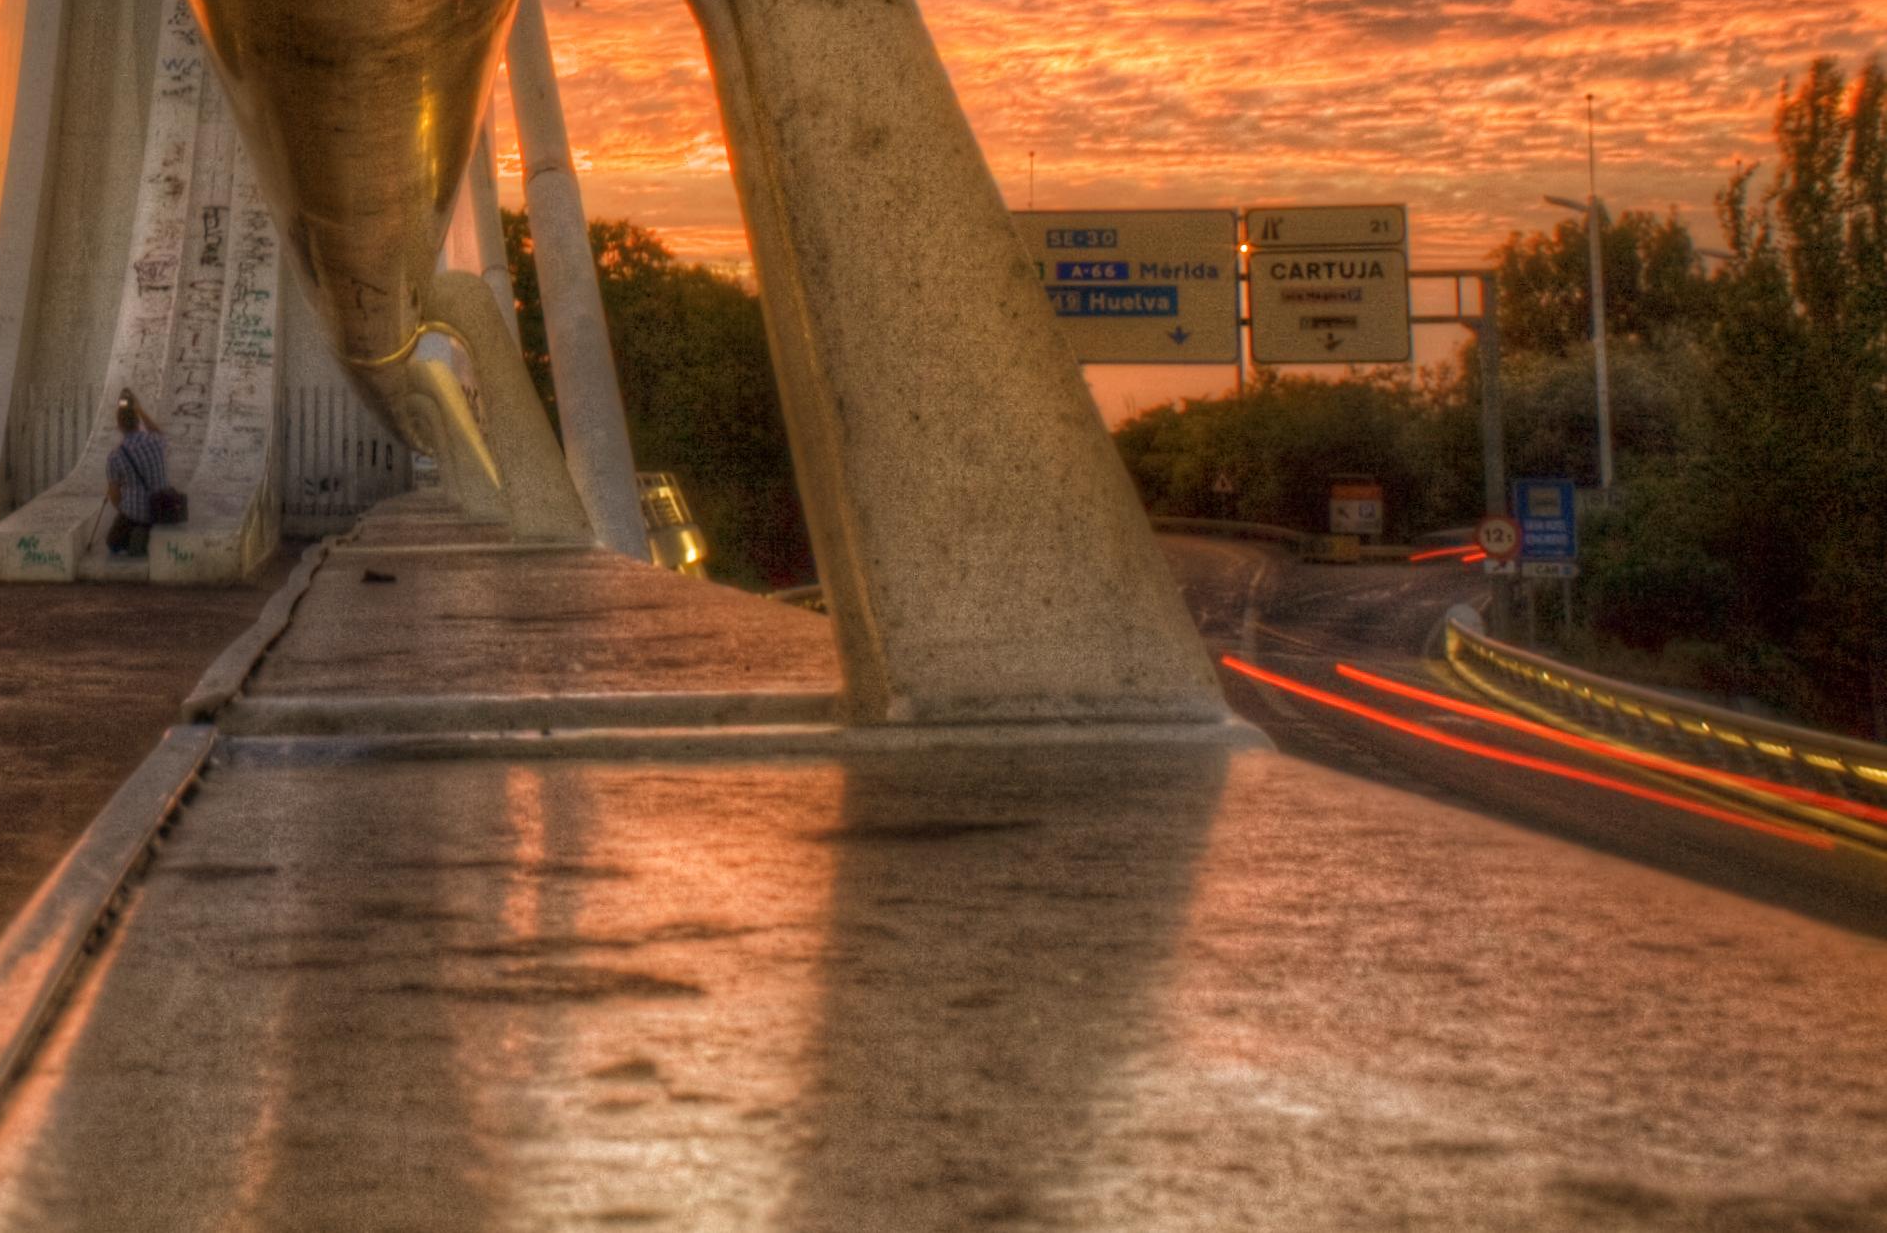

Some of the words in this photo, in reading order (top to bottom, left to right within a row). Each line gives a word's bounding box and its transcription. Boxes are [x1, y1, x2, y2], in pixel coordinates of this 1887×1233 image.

[1371, 220, 1390, 232] 21
[1049, 231, 1115, 246] SE-30
[1070, 264, 1117, 279] A-66
[1271, 261, 1383, 280] CARTUJA
[1090, 293, 1169, 311] Huelva
[1485, 528, 1504, 542] 12
